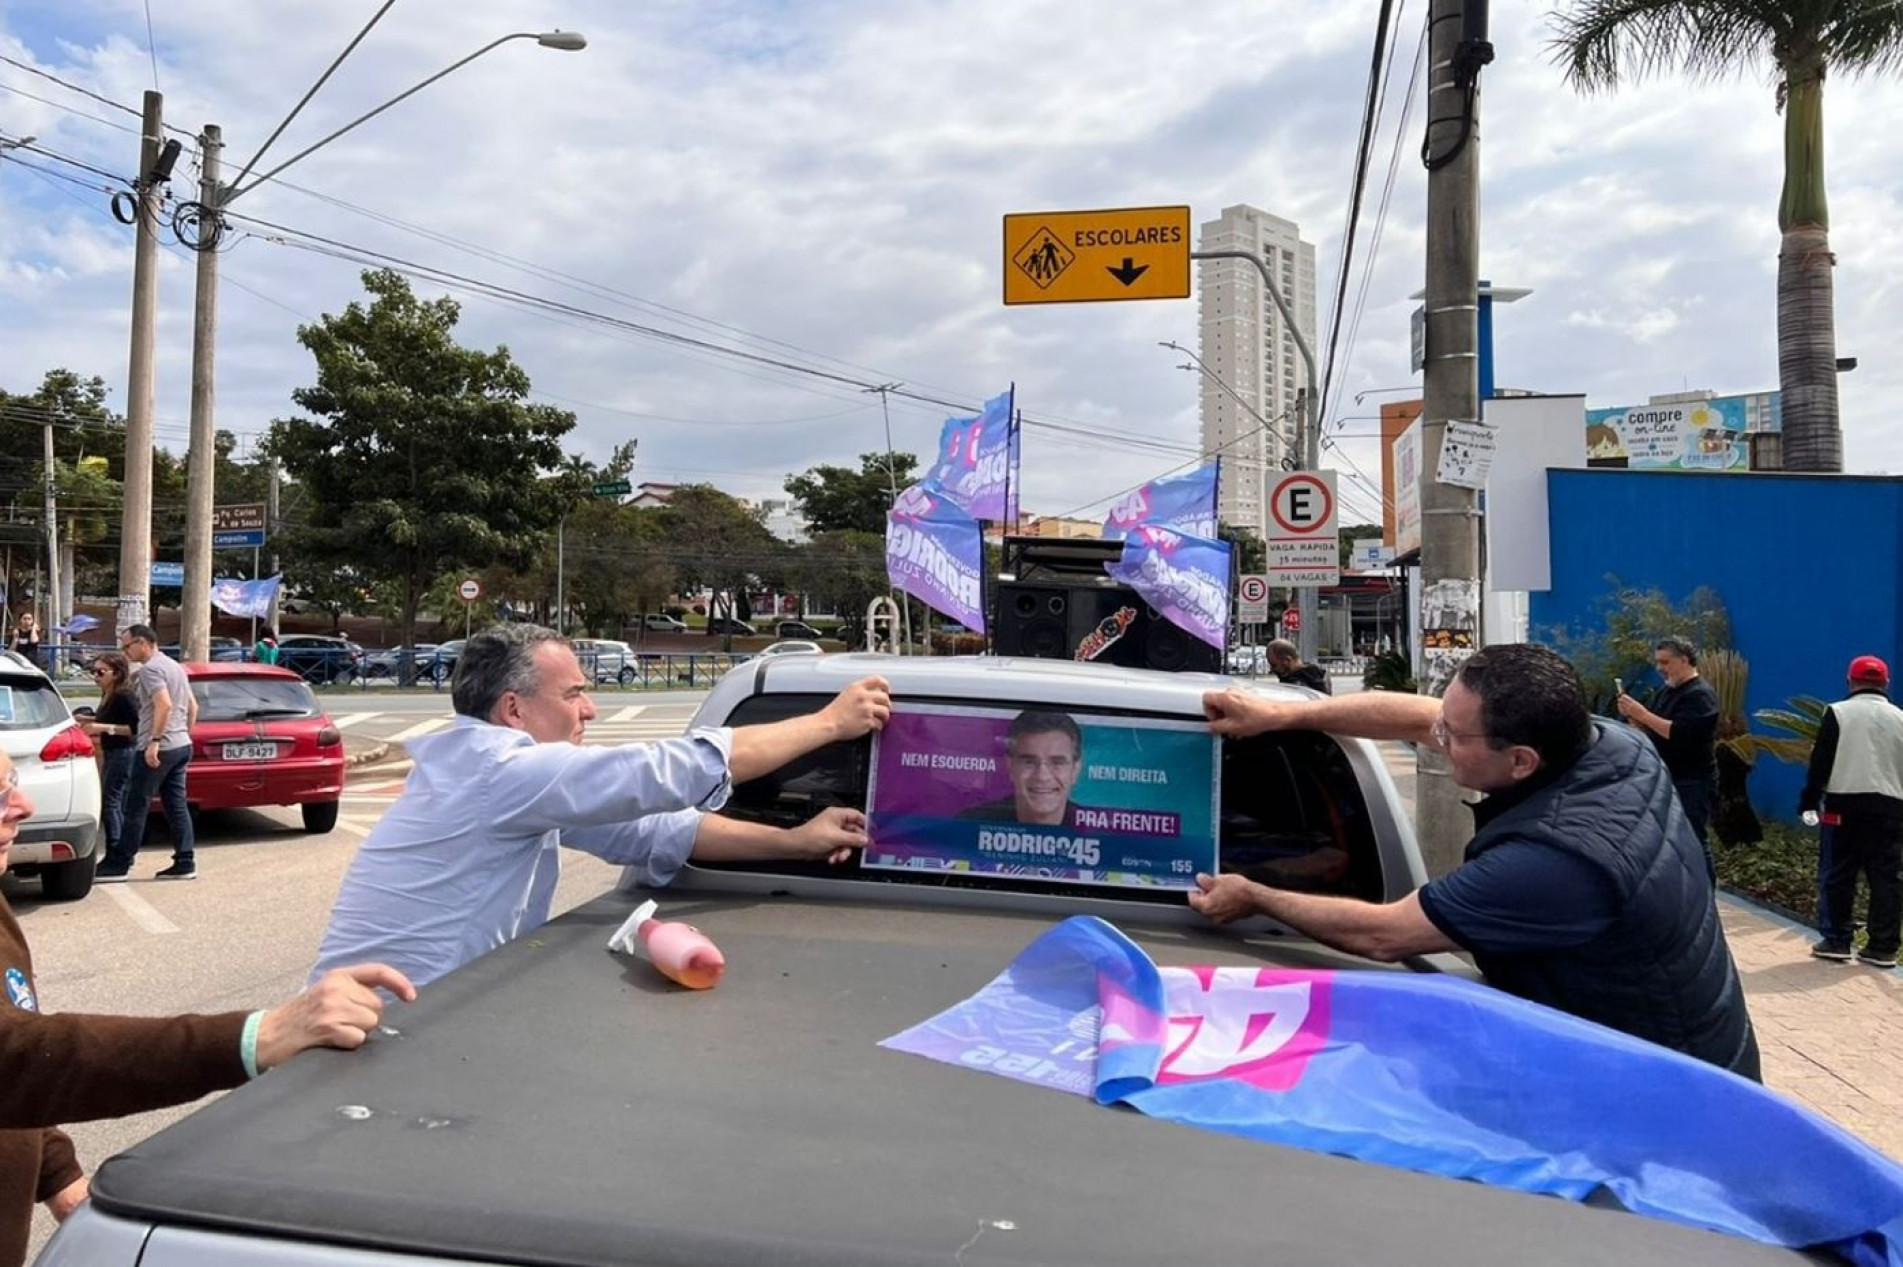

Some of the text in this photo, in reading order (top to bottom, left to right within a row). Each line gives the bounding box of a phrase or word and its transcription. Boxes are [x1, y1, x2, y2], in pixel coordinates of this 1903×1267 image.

[1075, 226, 1182, 247] ESCOLARES
[1628, 409, 1683, 425] compre
[1290, 488, 1312, 521] E
[234, 508, 257, 517] Carlos
[230, 520, 239, 528] de
[241, 519, 262, 528] Souza
[214, 534, 248, 544] Campolim
[1269, 543, 1295, 552] VAGA
[1294, 572, 1328, 581] VAGAS
[1249, 583, 1260, 597] E
[226, 747, 273, 758] DLF 9427
[901, 752, 997, 773] NEM ESQUERDA
[1088, 765, 1168, 785] NEM DIREITA
[1075, 809, 1176, 834] PRA FRENTE!
[1068, 838, 1101, 866] 45
[1171, 859, 1193, 873] 155
